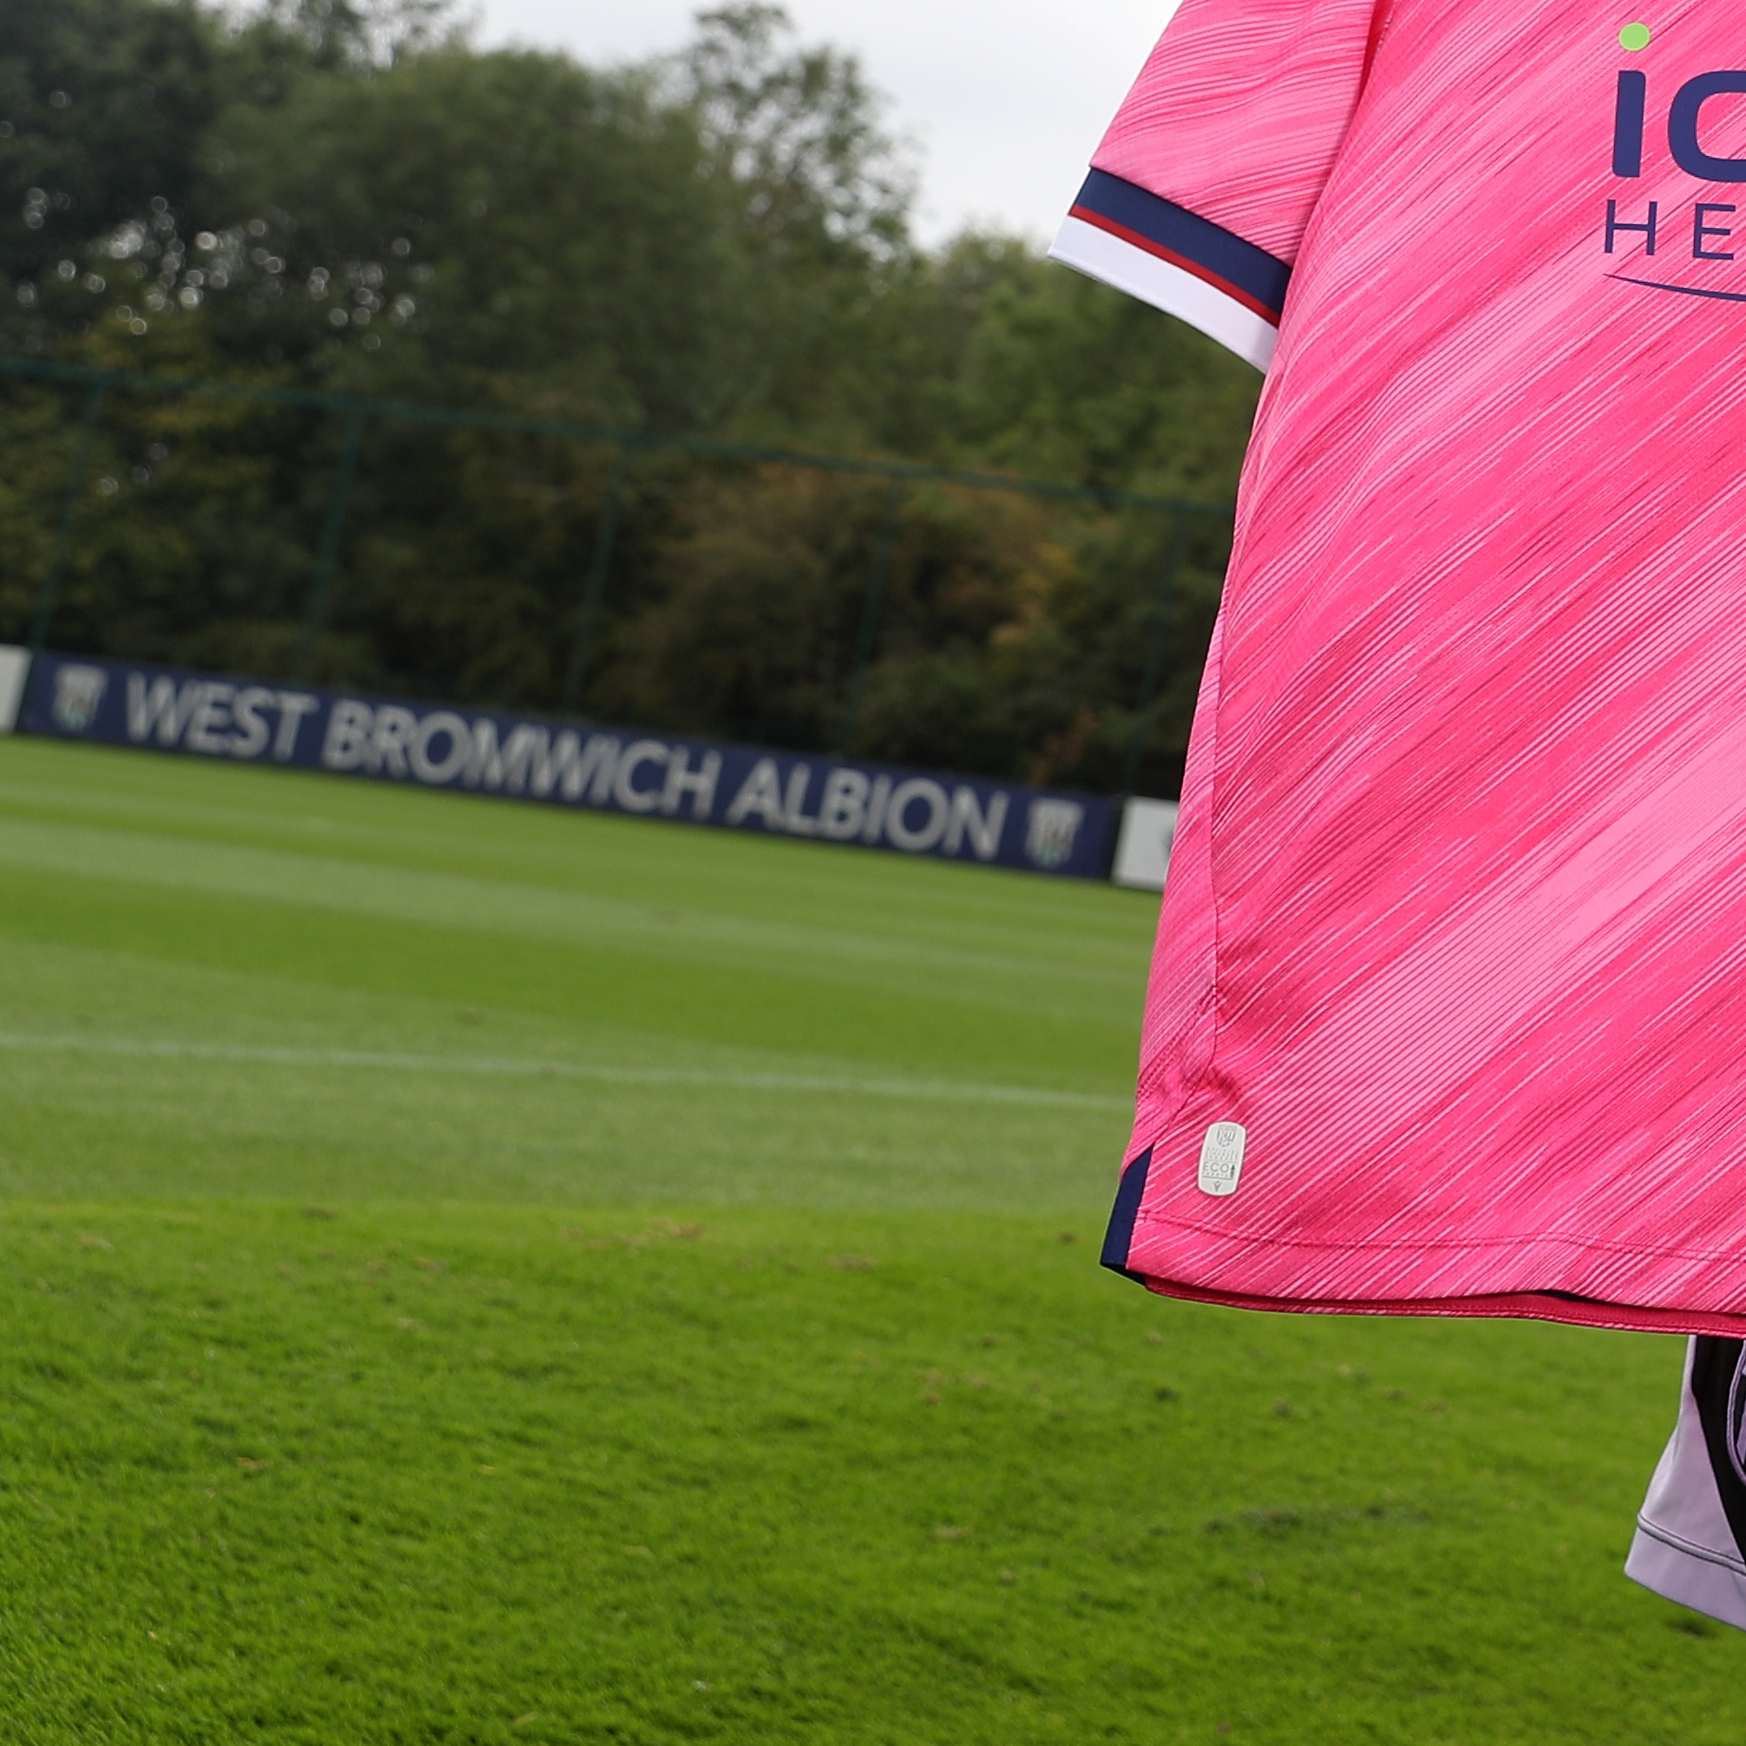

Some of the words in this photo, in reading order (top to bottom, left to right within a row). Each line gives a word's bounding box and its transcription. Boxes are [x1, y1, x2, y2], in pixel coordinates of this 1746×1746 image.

[126, 670, 320, 762] WEST
[321, 697, 722, 821] BROMWICH
[725, 756, 1010, 861] ALBION
[1203, 1161, 1230, 1174] ECO
